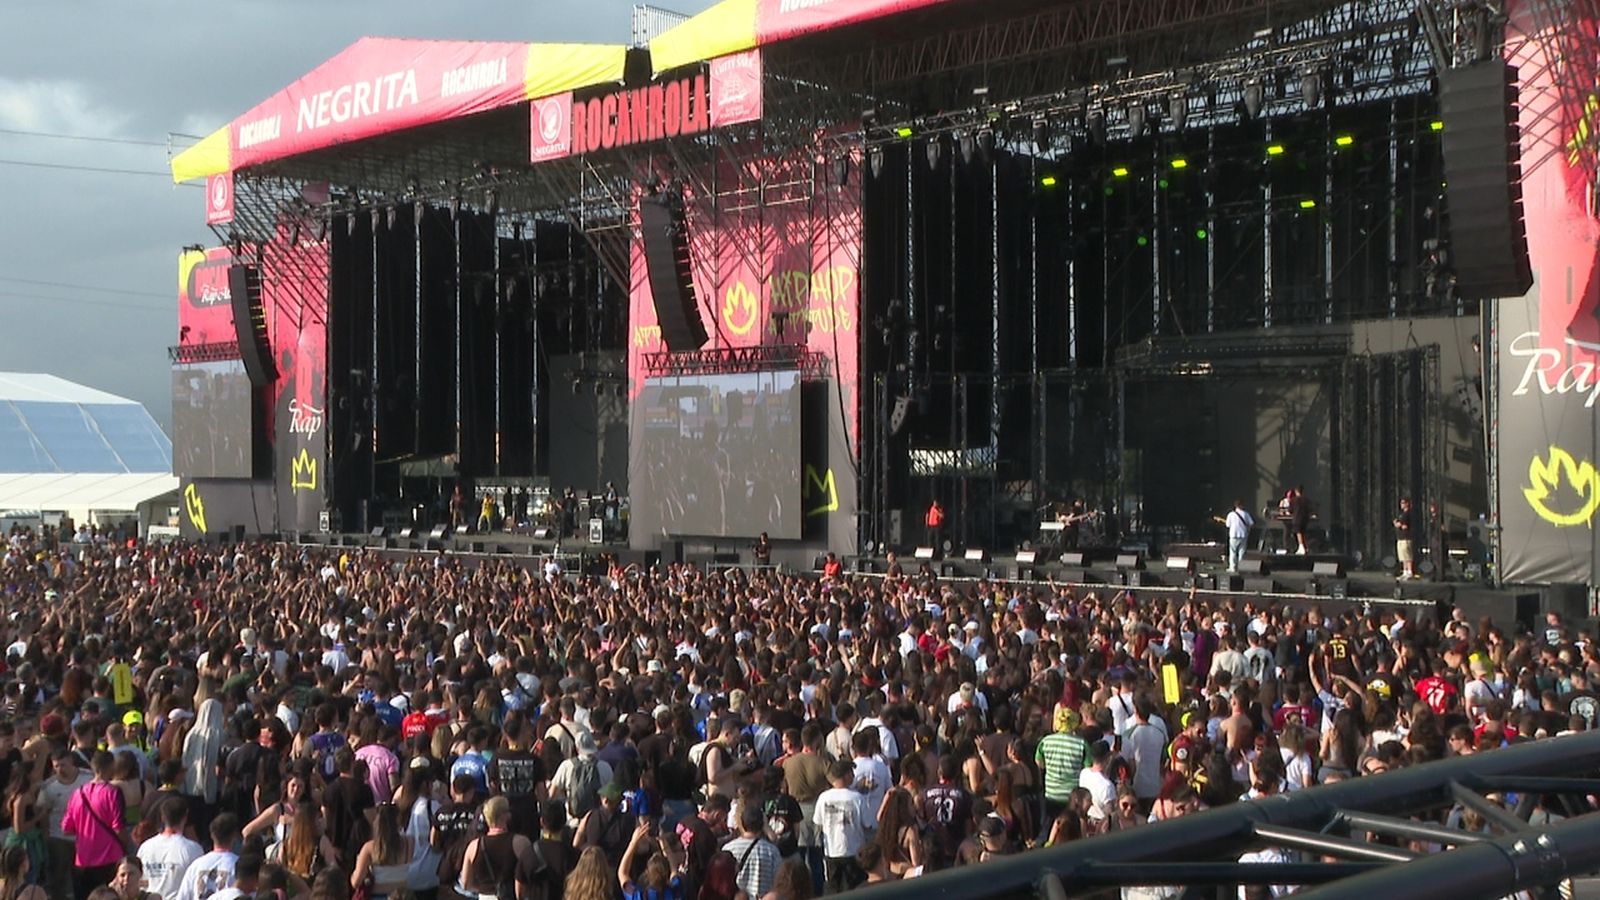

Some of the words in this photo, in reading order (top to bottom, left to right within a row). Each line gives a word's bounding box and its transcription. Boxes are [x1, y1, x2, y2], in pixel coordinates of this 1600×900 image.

[440, 57, 507, 98] ROCANROLA
[296, 68, 419, 133] NEGRITA
[572, 74, 708, 155] ROCANROLA
[768, 269, 809, 307] HIP
[811, 265, 853, 303] HOP
[288, 398, 324, 441] Rap
[1331, 643, 1346, 659] 13
